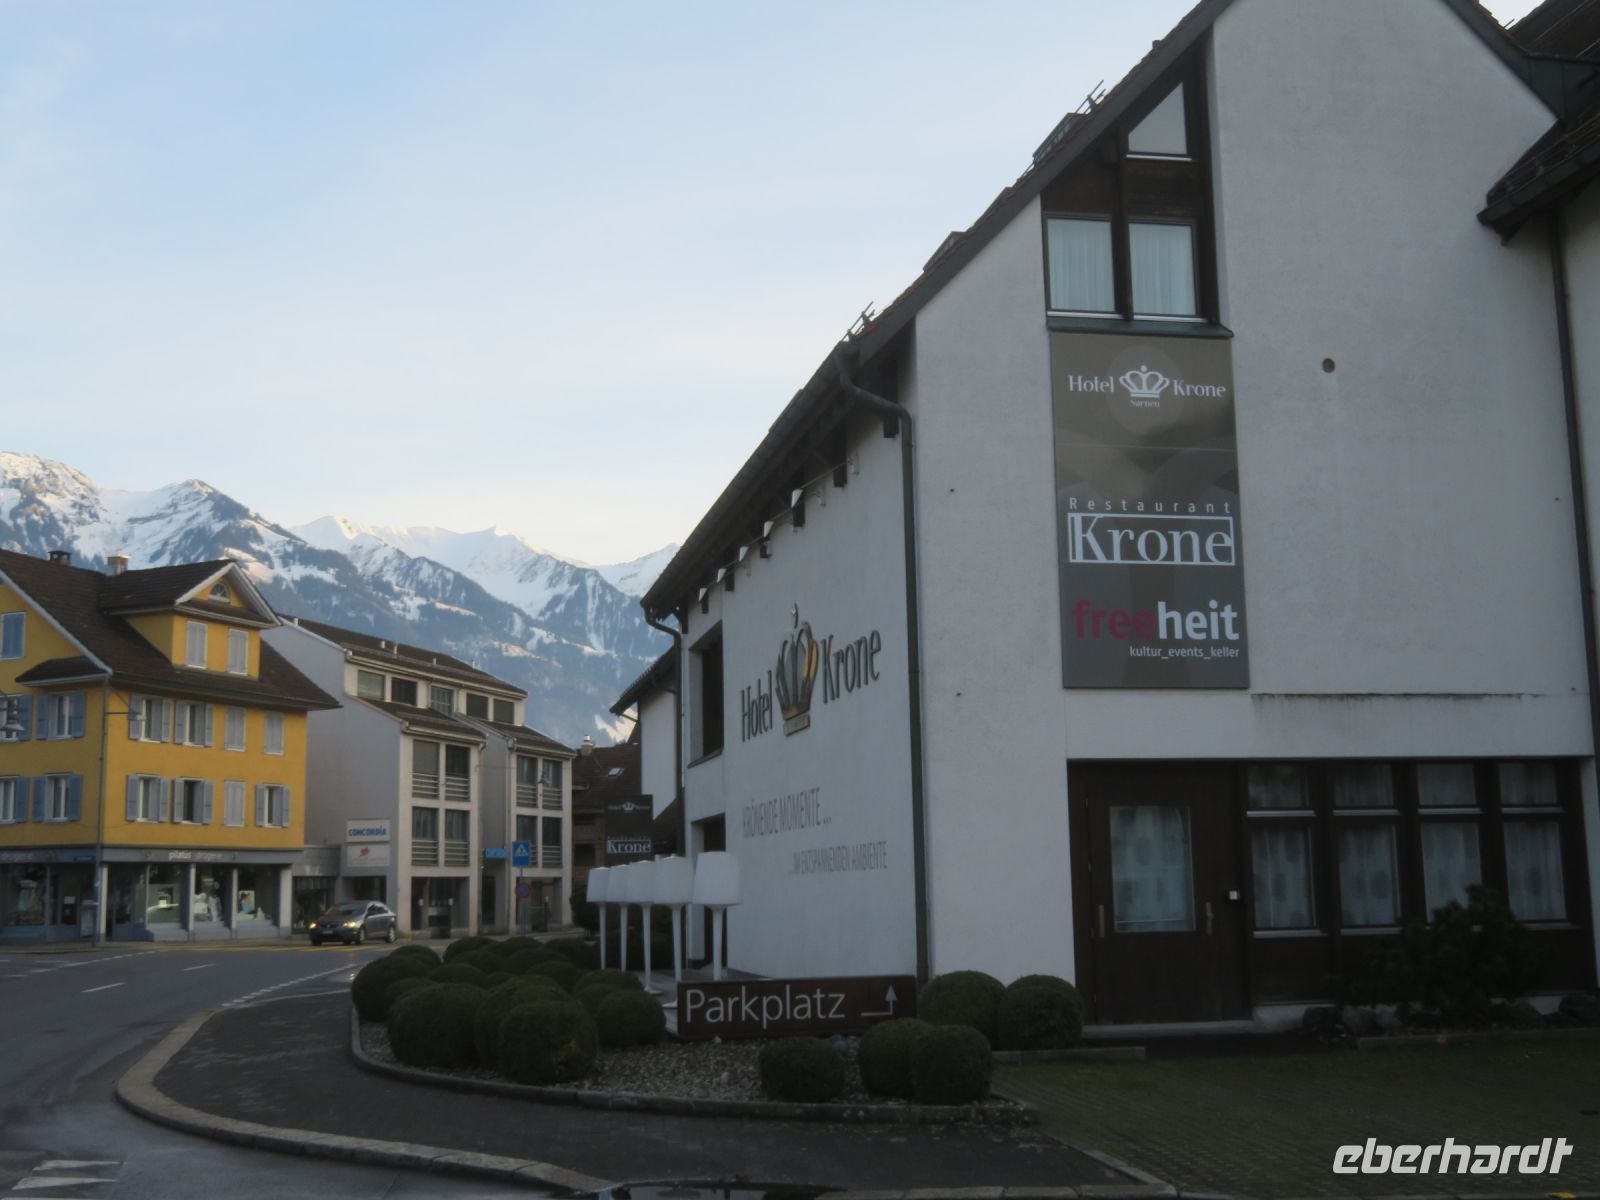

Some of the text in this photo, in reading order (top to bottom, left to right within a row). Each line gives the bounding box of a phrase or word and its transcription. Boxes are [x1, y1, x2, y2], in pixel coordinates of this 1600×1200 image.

[1068, 375, 1227, 398] Hotel Krone
[1130, 399, 1160, 408] Sarnen
[1069, 497, 1231, 514] Restaurant
[1072, 514, 1235, 565] Krone
[740, 629, 882, 742] Hotel Krone
[348, 826, 387, 837] CONCORDIA
[607, 840, 651, 854] Krone
[686, 984, 846, 1030] Parkplatz
